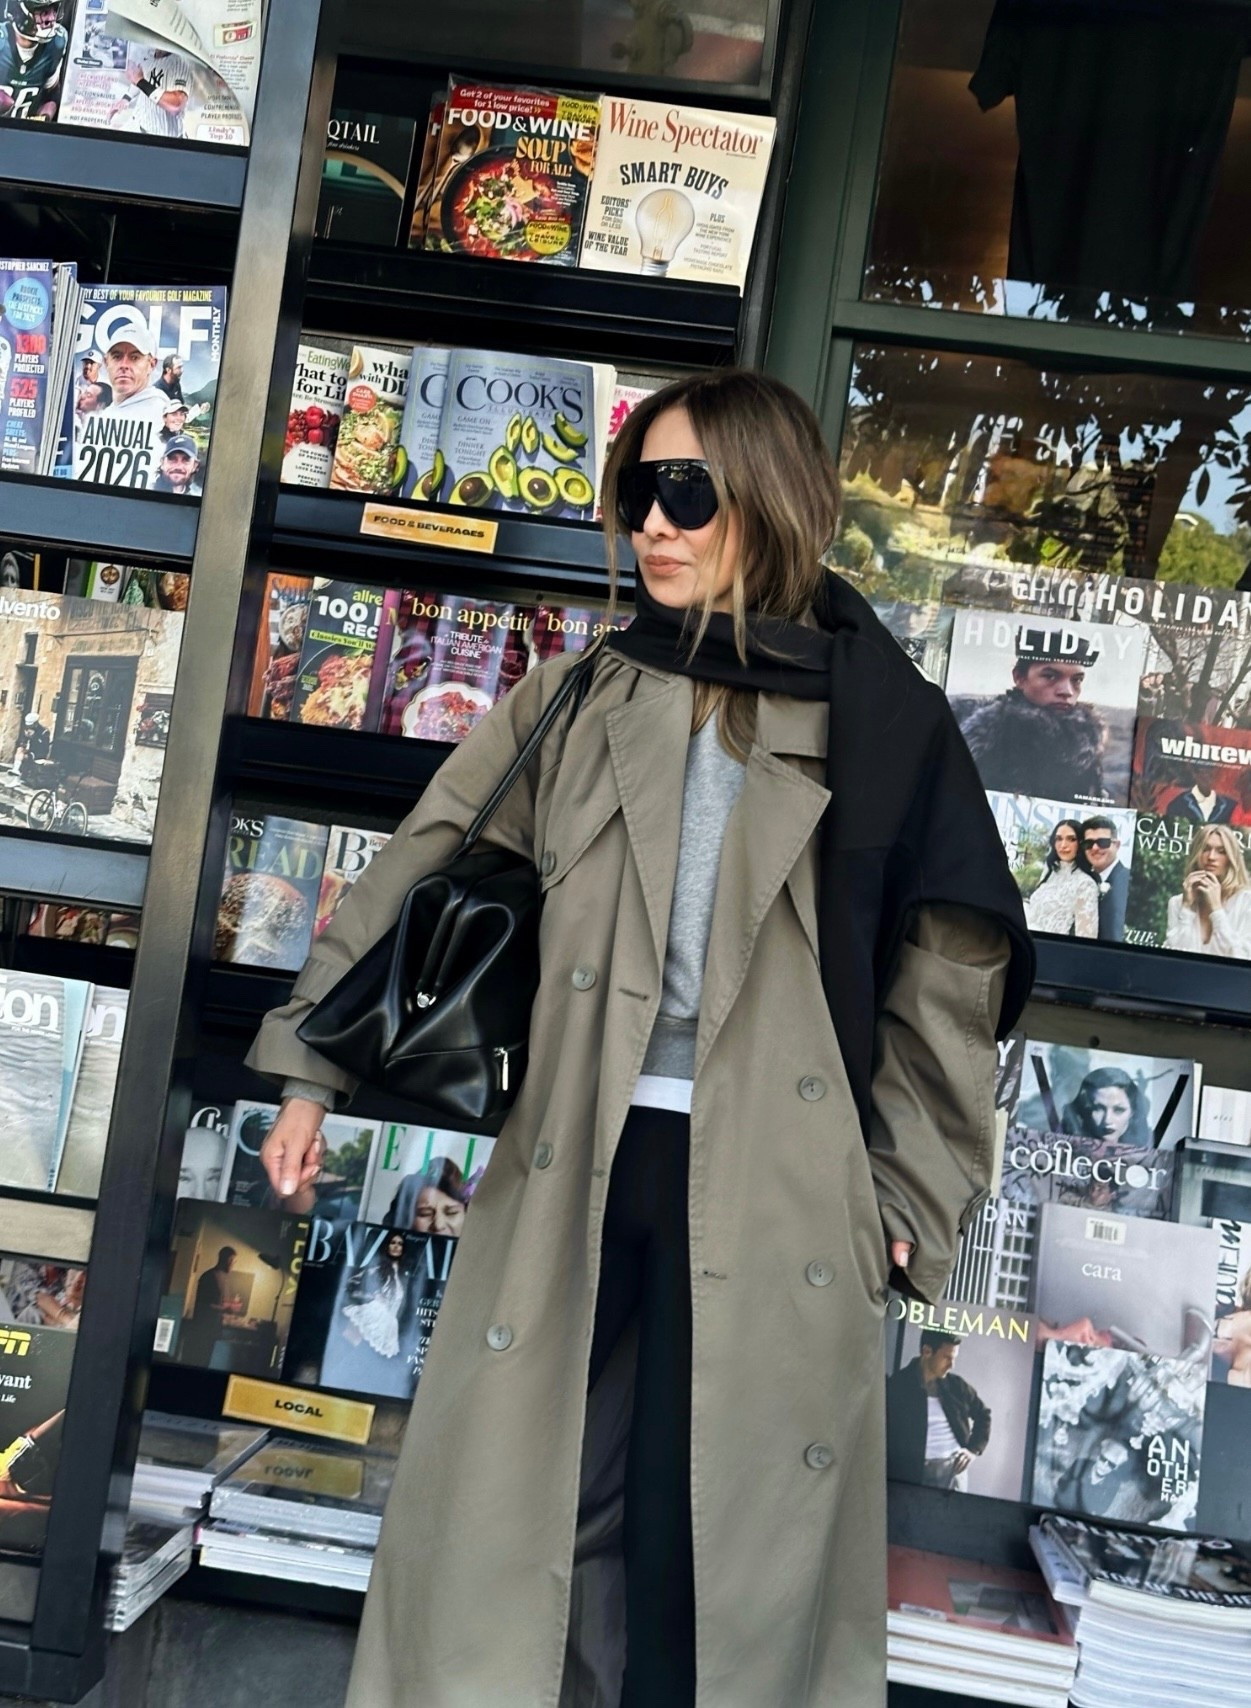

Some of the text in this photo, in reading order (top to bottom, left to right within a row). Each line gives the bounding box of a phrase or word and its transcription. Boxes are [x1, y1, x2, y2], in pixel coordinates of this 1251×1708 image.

[474, 100, 486, 108] for
[493, 102, 508, 111] low
[493, 94, 512, 103] your
[514, 96, 549, 107] favorites
[448, 108, 592, 141] FOOD & WINE
[610, 101, 764, 153] Wine Spectator
[516, 136, 567, 163] SOUP
[530, 161, 573, 178] FOR ALL!
[620, 161, 729, 200] SMART BUYS
[604, 205, 625, 218] PICKS
[709, 212, 725, 223] PLUS
[588, 231, 606, 243] WINE
[595, 242, 609, 253] THE
[610, 244, 629, 256] YEAR
[93, 288, 109, 300] BEST
[110, 289, 117, 300] OF
[135, 290, 166, 301] FAVOURITE
[167, 290, 182, 301] GOLF
[182, 290, 213, 302] MAGAZINE
[211, 306, 221, 362] MONTHLY
[14, 353, 39, 364] PLAYERS
[297, 363, 326, 382] hat
[359, 373, 381, 384] with
[10, 377, 38, 399] 525
[297, 378, 322, 395] for
[456, 374, 584, 424] COOK'S
[82, 416, 154, 450] ANNUAL
[78, 446, 152, 490] 2026
[373, 515, 485, 538] FOOD & BEVERAGES
[314, 595, 369, 623] 100
[412, 597, 531, 633] bon appétit
[342, 620, 379, 639] REC
[547, 612, 588, 636] bon
[430, 636, 502, 654] ITALIAN AMERICAN
[450, 630, 484, 644] TRIBUTE
[963, 614, 1133, 660] HOLIDAY
[450, 647, 482, 660] CUISINE
[1125, 929, 1158, 944] THE
[1010, 1139, 1167, 1191] collector
[1082, 1263, 1123, 1281] cara
[274, 1399, 325, 1417] LOCAL
[1147, 1434, 1190, 1464] AN
[1146, 1458, 1189, 1482] OTH
[1161, 1477, 1188, 1495] ER
